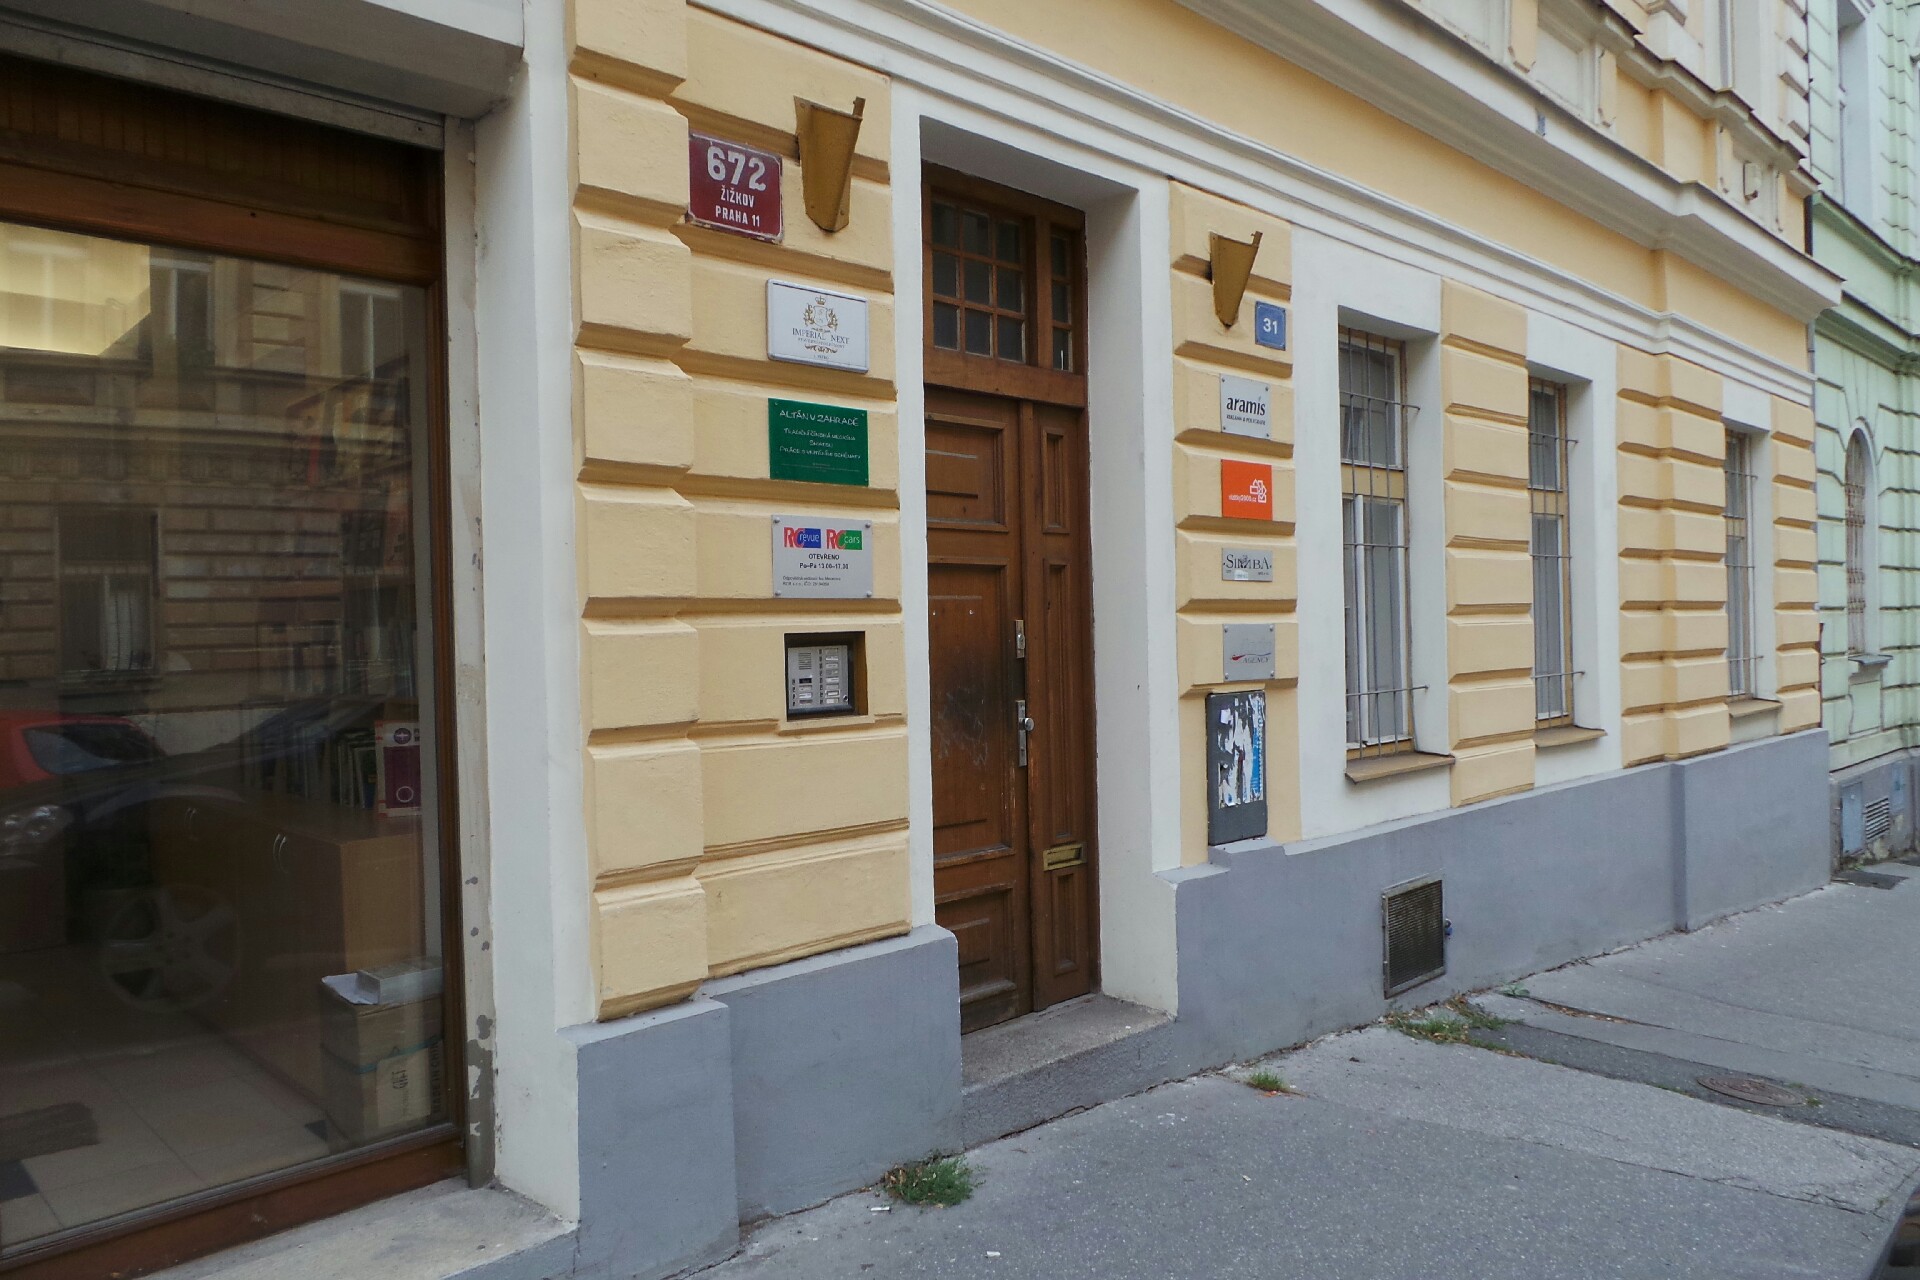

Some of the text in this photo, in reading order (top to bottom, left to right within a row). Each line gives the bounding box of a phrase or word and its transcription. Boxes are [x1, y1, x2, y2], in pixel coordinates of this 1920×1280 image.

[707, 145, 767, 191] 672
[720, 184, 755, 208] ŽIŽKOV
[715, 205, 760, 227] PRAHA 11
[792, 328, 826, 341] IMPERIAL
[830, 335, 850, 345] NEXT
[1263, 318, 1278, 335] 31
[780, 409, 808, 421] ALTÁN
[1226, 397, 1266, 416] aramis
[784, 527, 860, 550] RC revue RC cars
